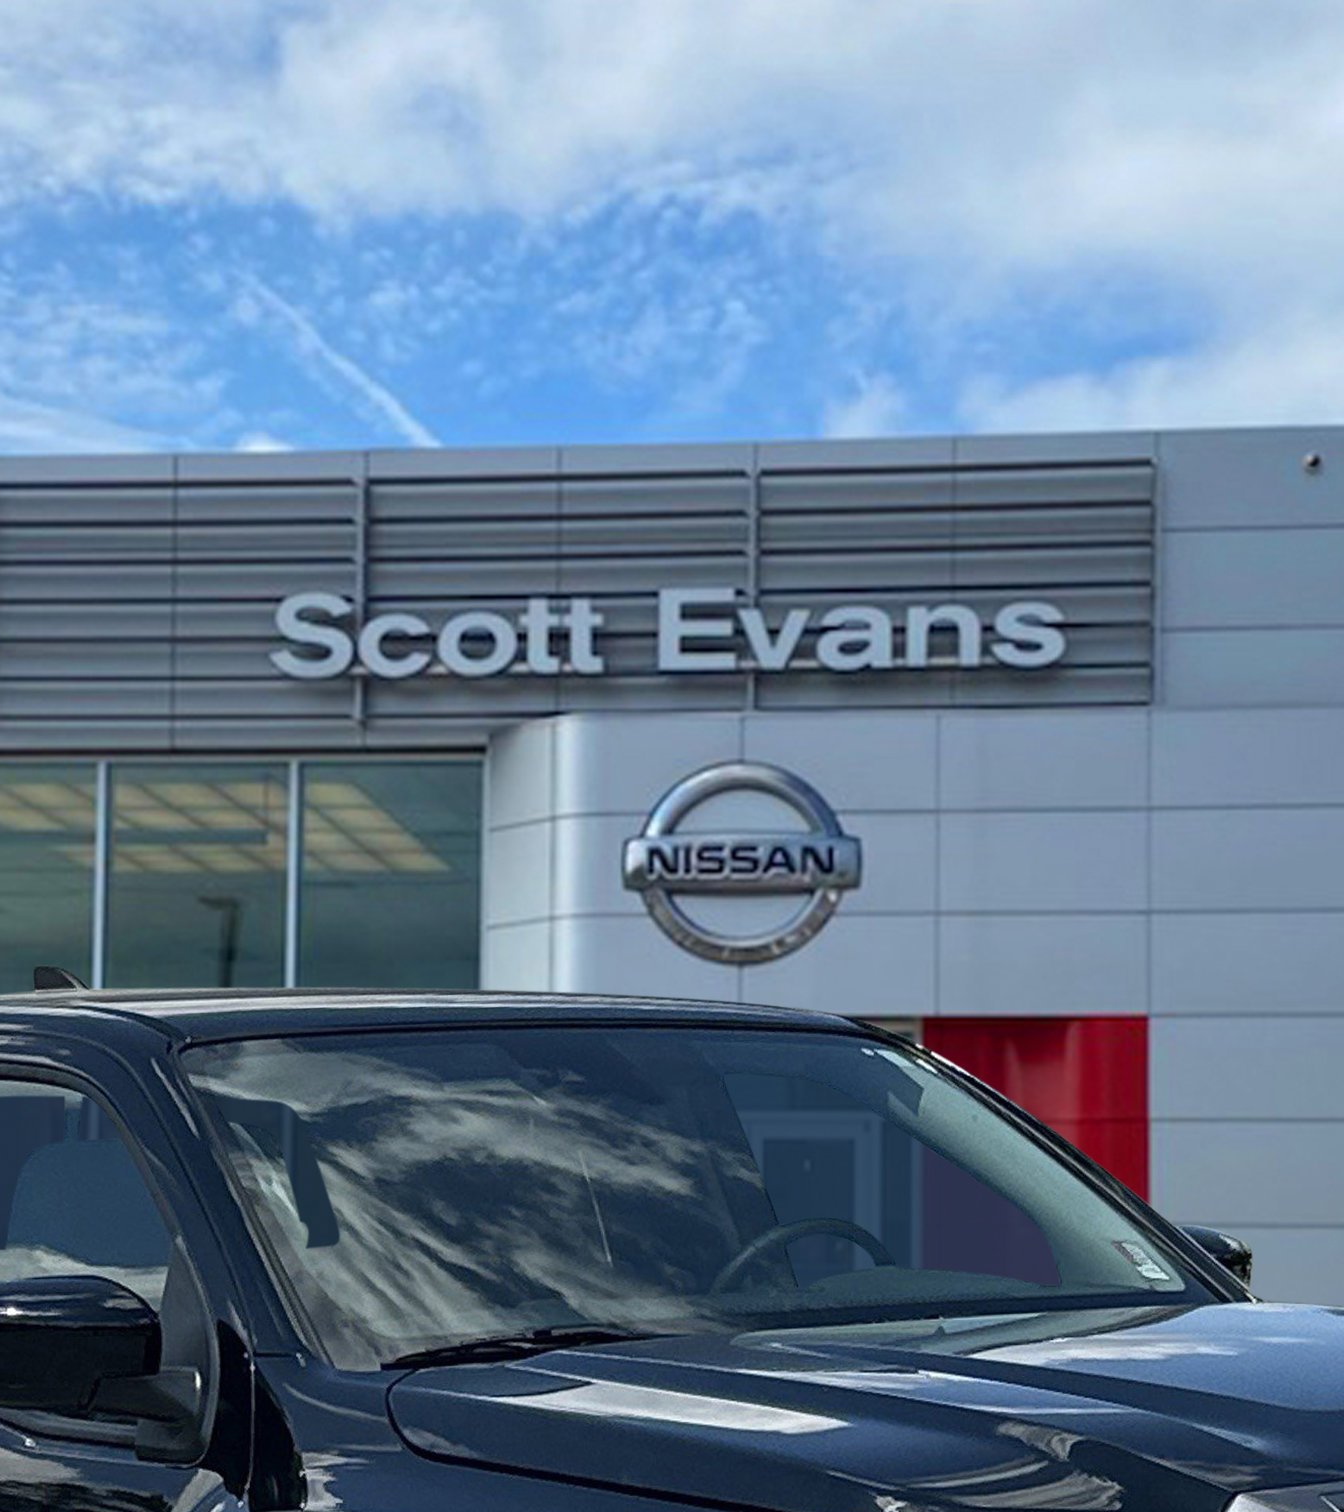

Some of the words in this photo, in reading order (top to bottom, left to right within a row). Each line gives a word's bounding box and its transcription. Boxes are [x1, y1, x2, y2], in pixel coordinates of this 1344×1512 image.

[269, 590, 605, 680] Scott
[657, 586, 1069, 673] Evans
[645, 845, 835, 876] NISSAN
